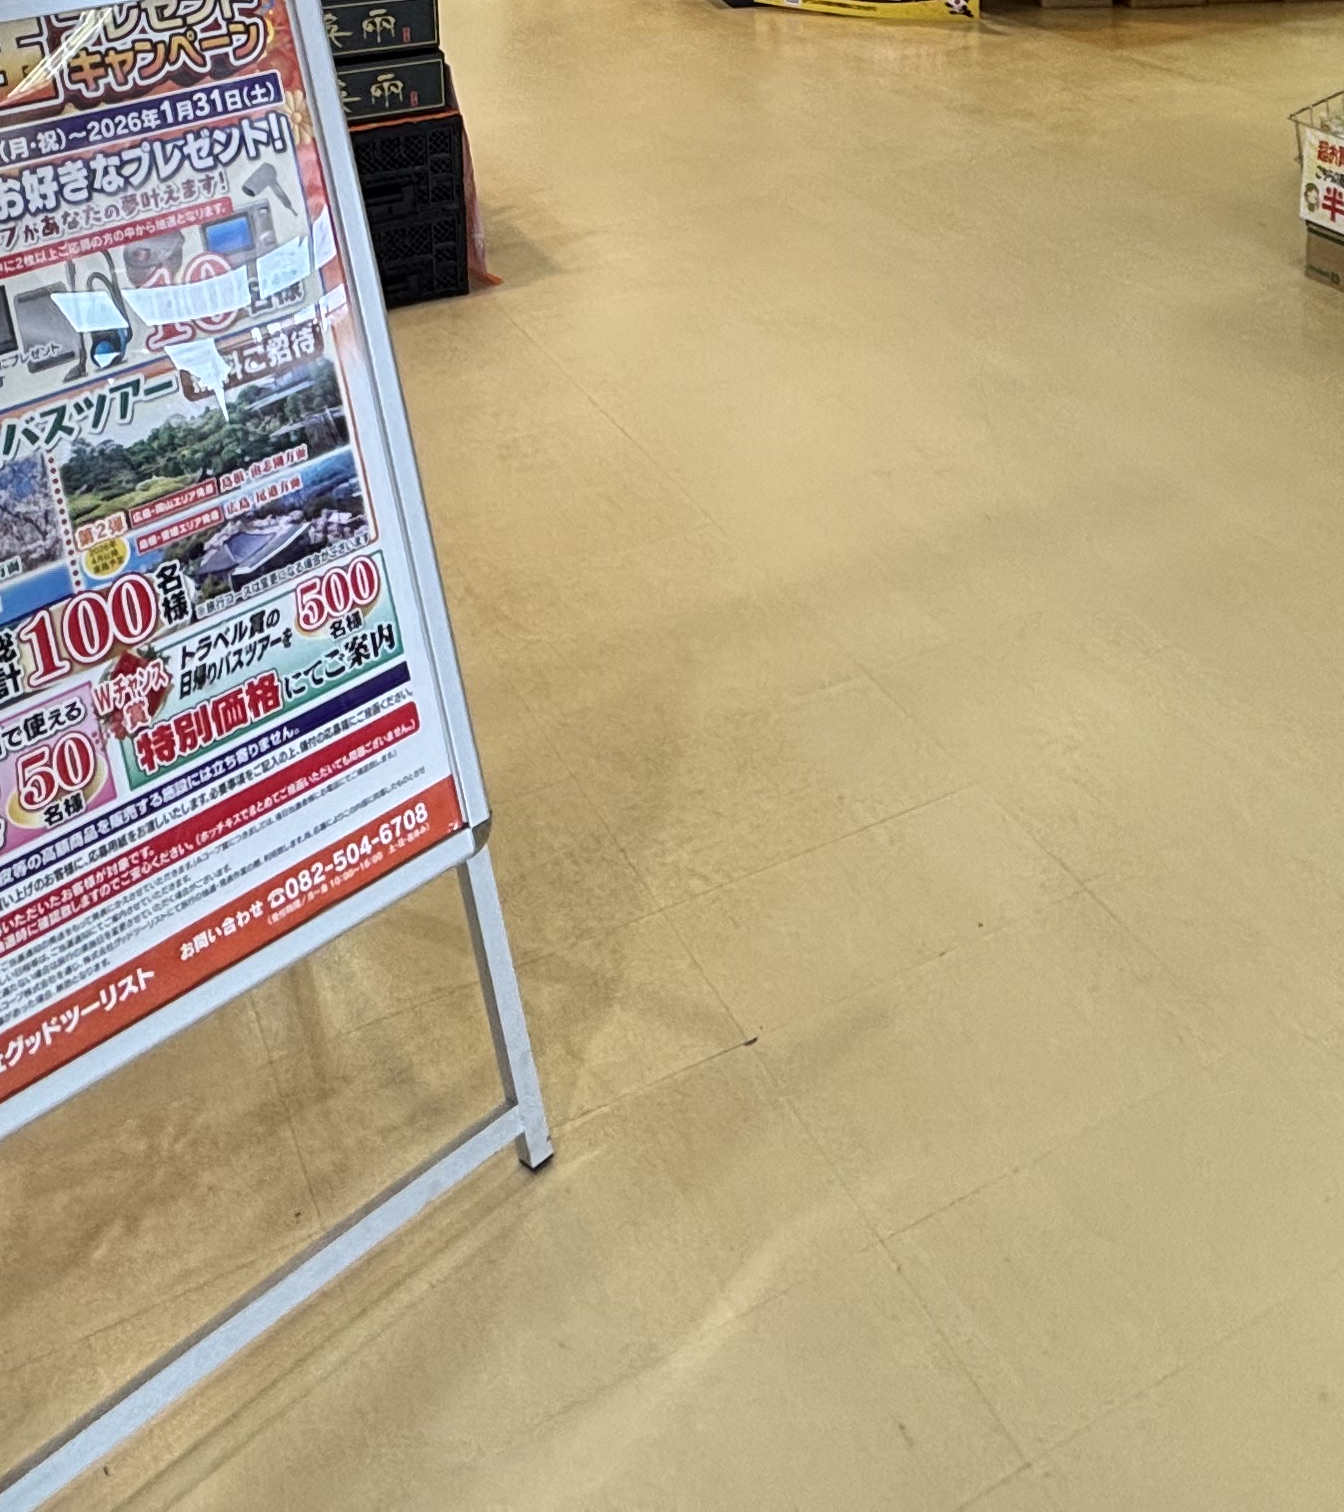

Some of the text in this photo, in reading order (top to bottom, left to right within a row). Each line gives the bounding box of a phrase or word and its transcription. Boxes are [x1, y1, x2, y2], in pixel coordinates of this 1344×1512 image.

[65, 16, 264, 94] キャンペーン
[75, 511, 127, 549] 第2弾
[14, 563, 164, 690] 100
[153, 554, 195, 630] 名様
[291, 549, 384, 636] 500
[328, 609, 364, 641] 名様
[175, 623, 295, 700] 日帰りバスツアーを
[176, 602, 283, 671] トラベル賞の
[92, 655, 170, 717] Wチャンス
[122, 697, 151, 731] 賞
[134, 619, 398, 778] 特別価格 にてご案内
[11, 727, 98, 816] 50
[41, 790, 86, 829] 名様
[178, 897, 265, 962] お問い合わせ
[282, 799, 429, 902] 082-504-6708
